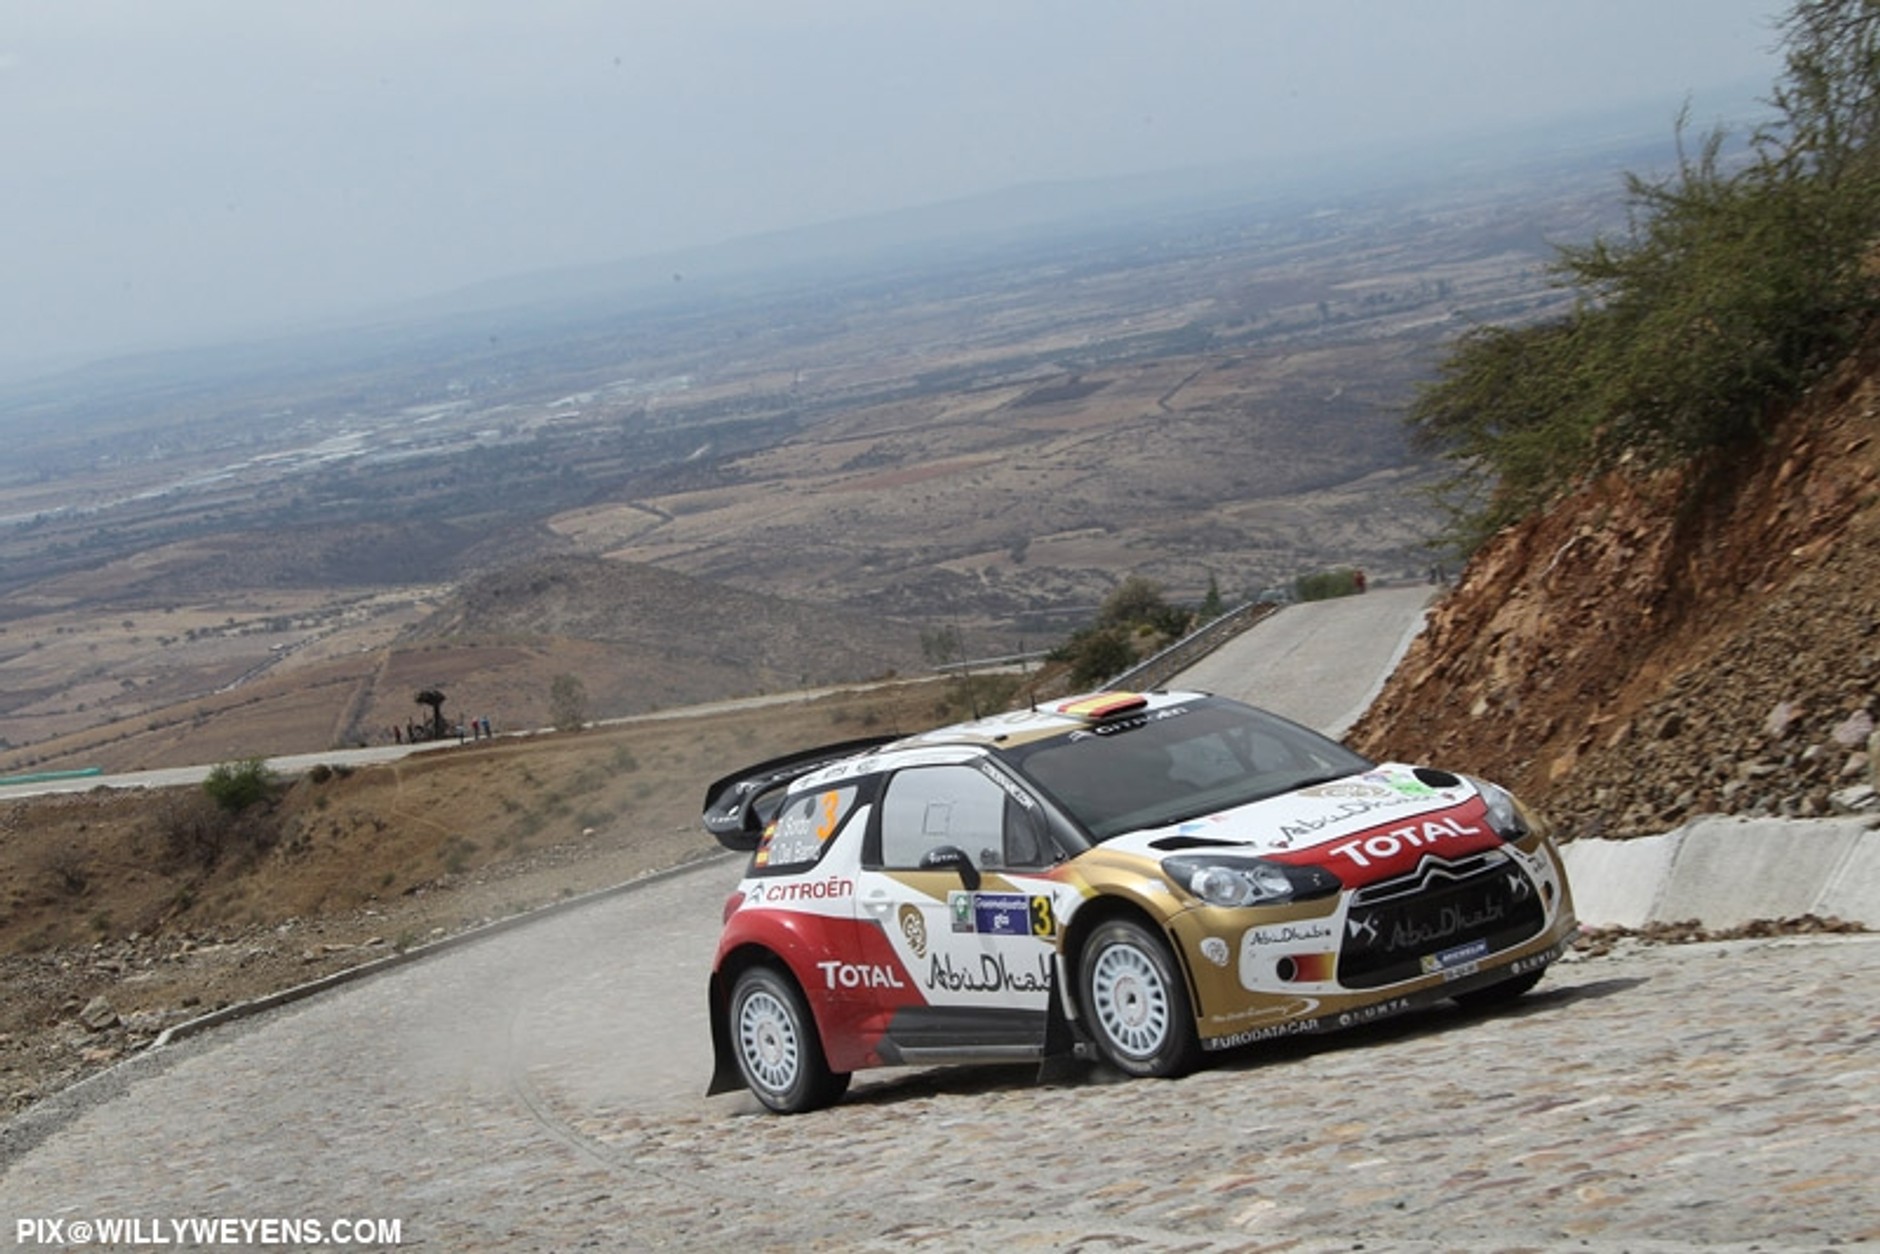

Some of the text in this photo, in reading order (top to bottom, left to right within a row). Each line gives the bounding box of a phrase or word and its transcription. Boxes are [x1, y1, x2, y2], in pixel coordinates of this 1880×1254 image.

[815, 789, 839, 840] 3
[1329, 817, 1481, 867] TOTAL
[1032, 896, 1053, 936] 3
[817, 960, 905, 989] TOTAL
